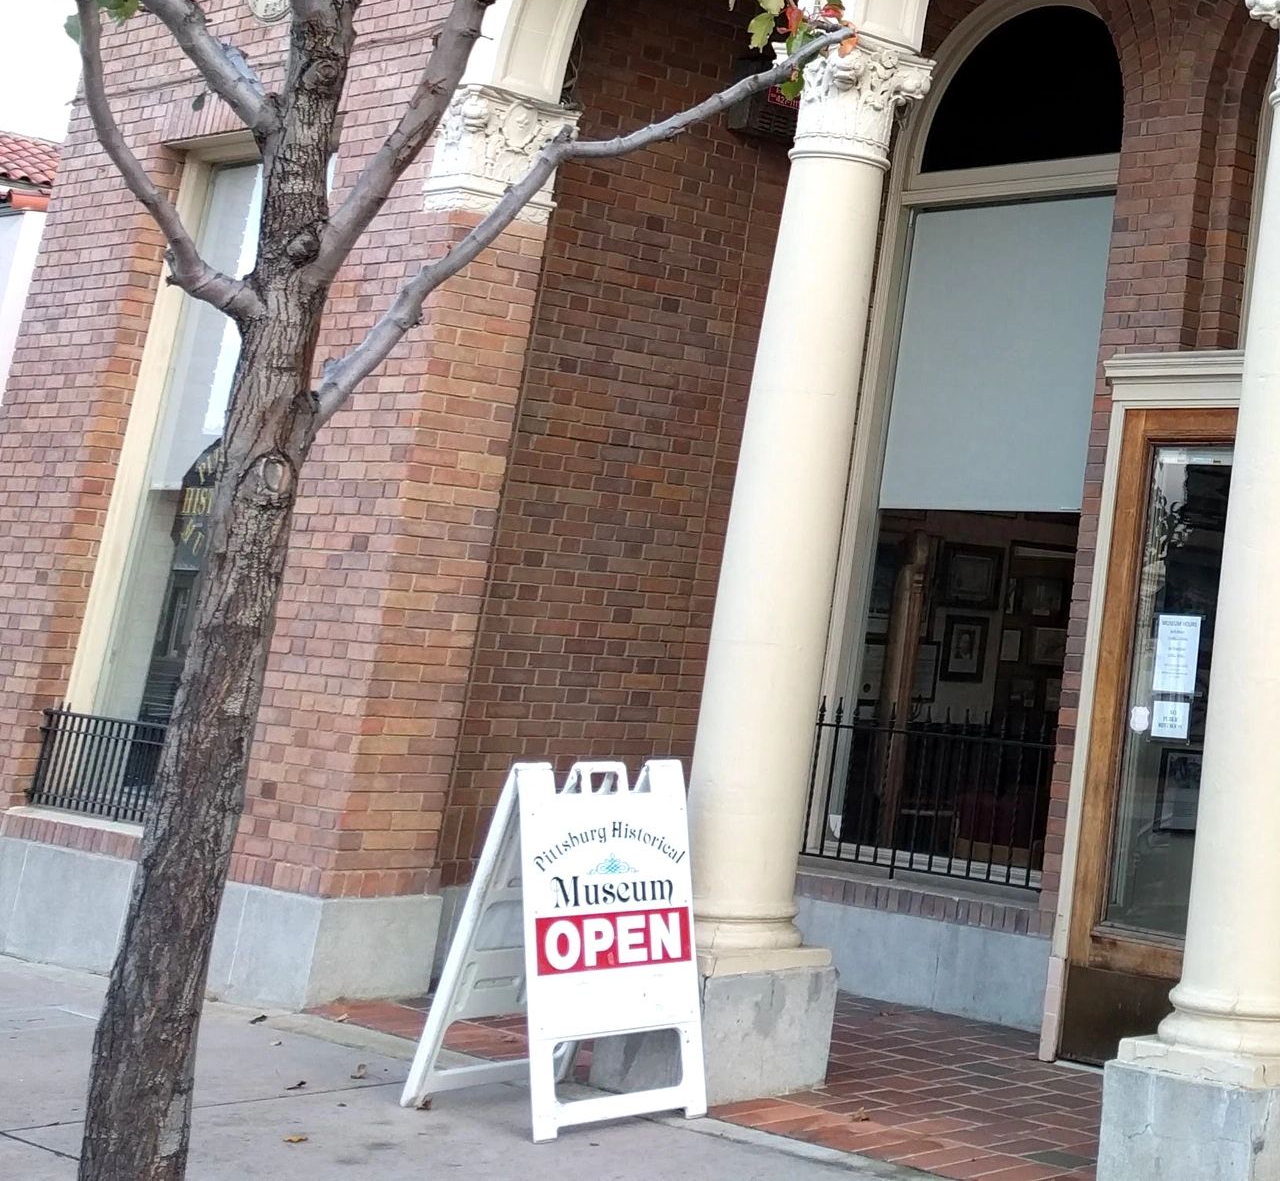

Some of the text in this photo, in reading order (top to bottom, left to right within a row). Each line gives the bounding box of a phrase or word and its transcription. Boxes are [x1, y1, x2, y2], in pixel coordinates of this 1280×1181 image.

[533, 821, 686, 873] Pittsburg Historical
[551, 875, 674, 908] Museum
[544, 911, 682, 971] OPEN
